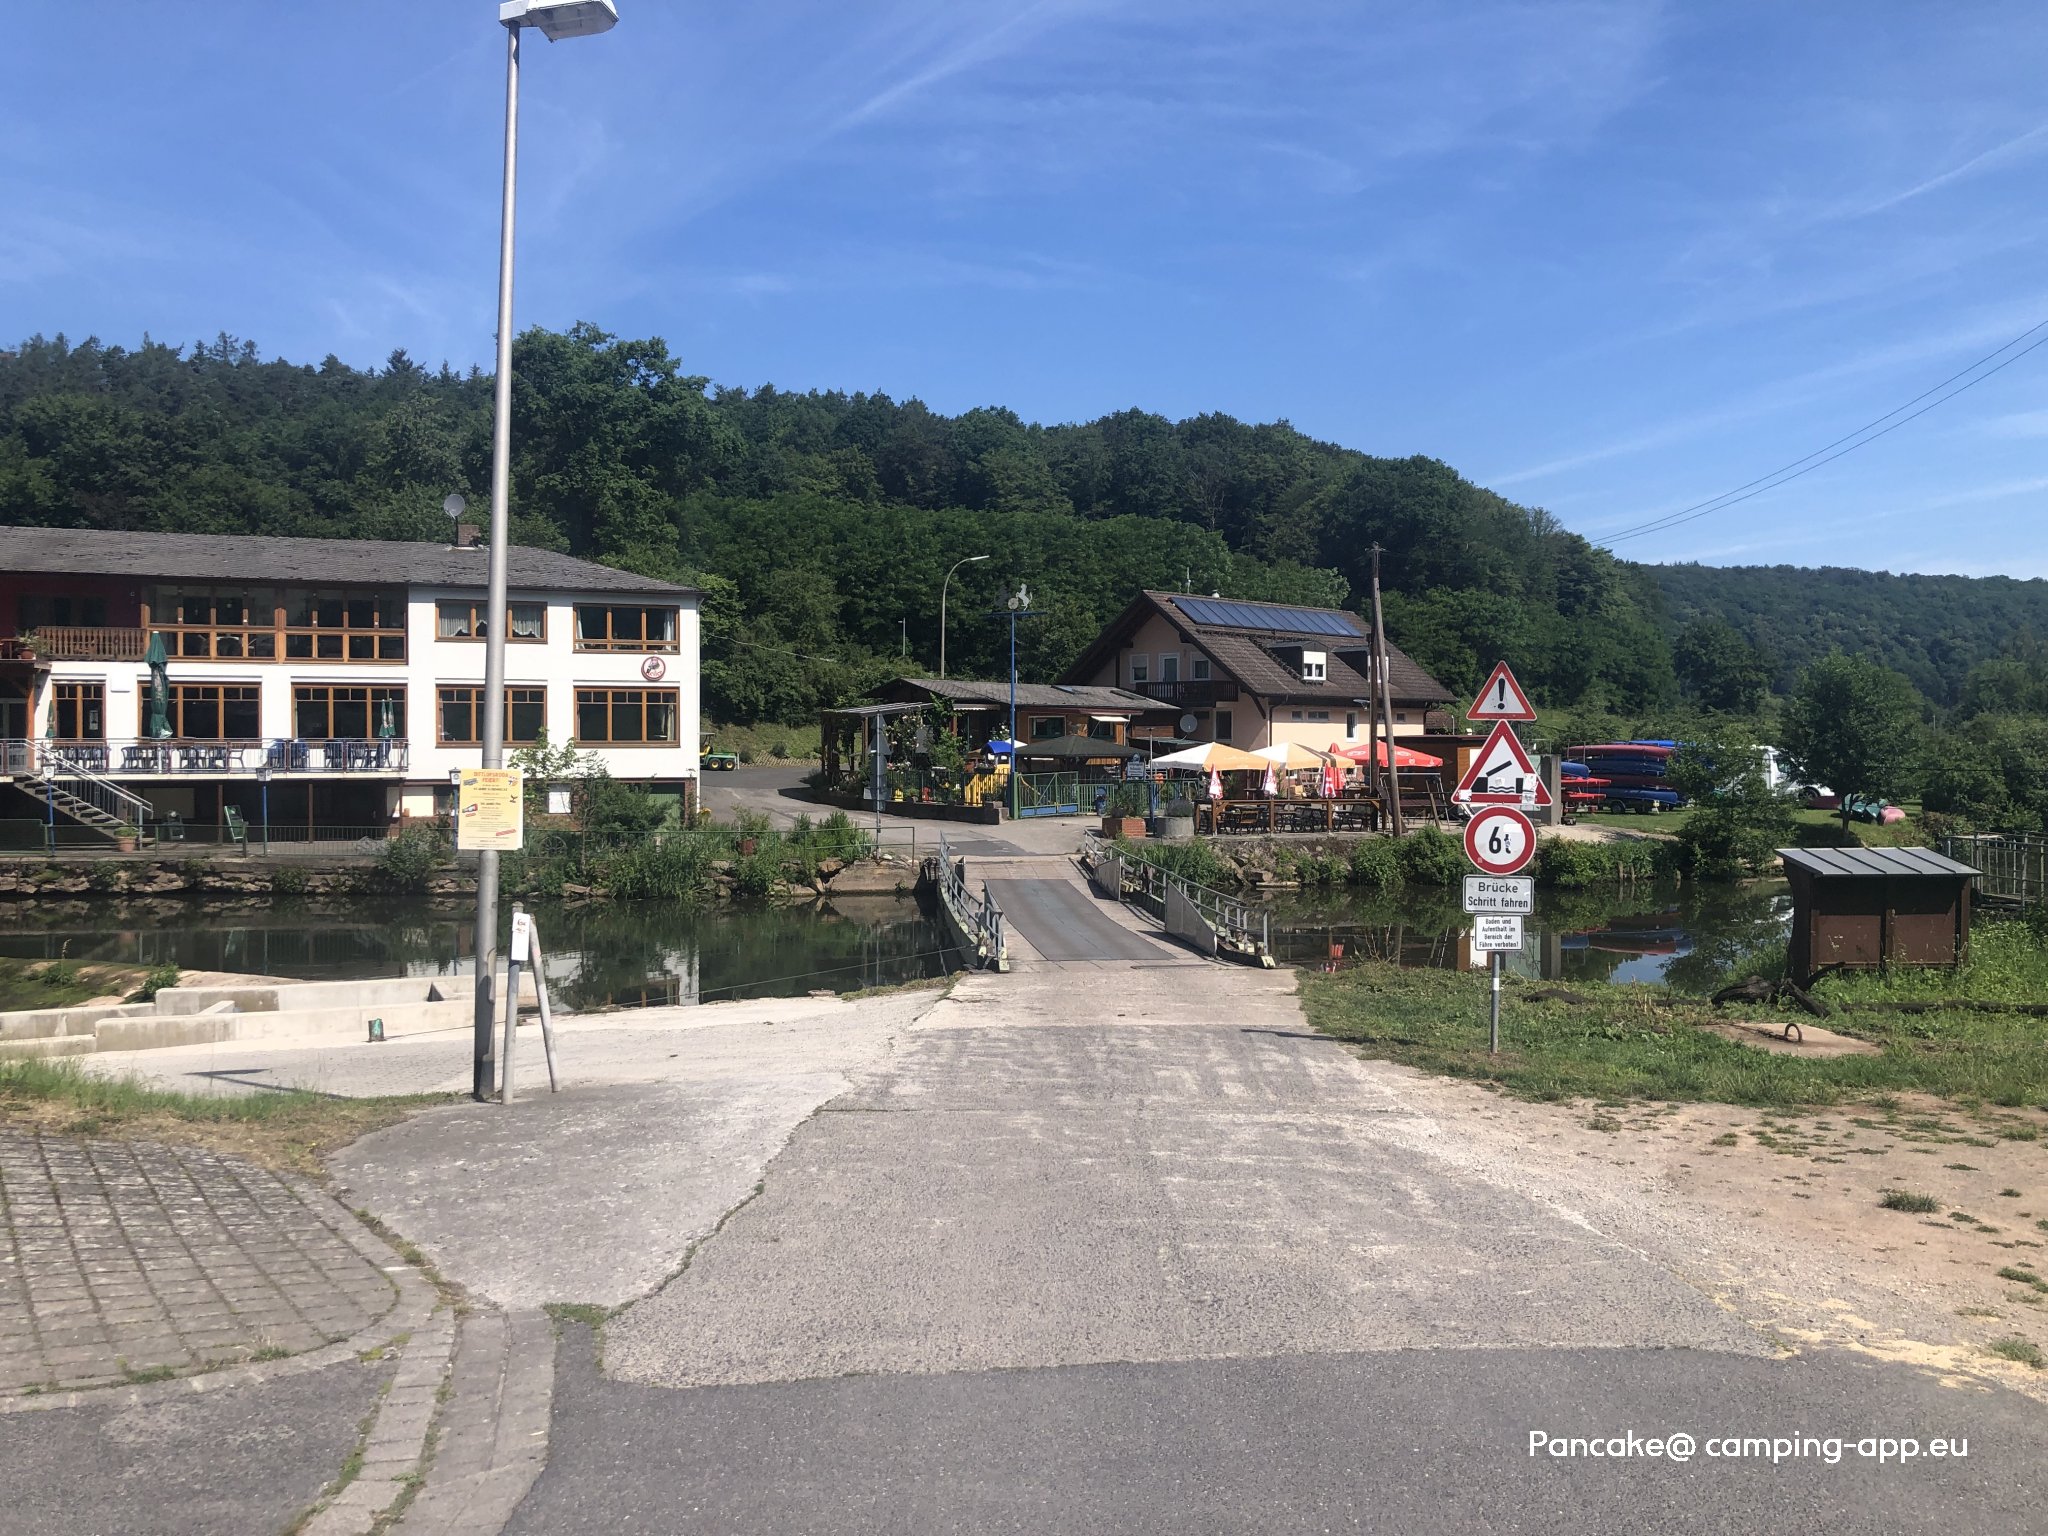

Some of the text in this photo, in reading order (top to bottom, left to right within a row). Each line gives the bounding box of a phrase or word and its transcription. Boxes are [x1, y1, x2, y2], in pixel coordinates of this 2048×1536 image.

[1478, 882, 1518, 893] Brücke
[1468, 896, 1528, 908] Schritt fahren
